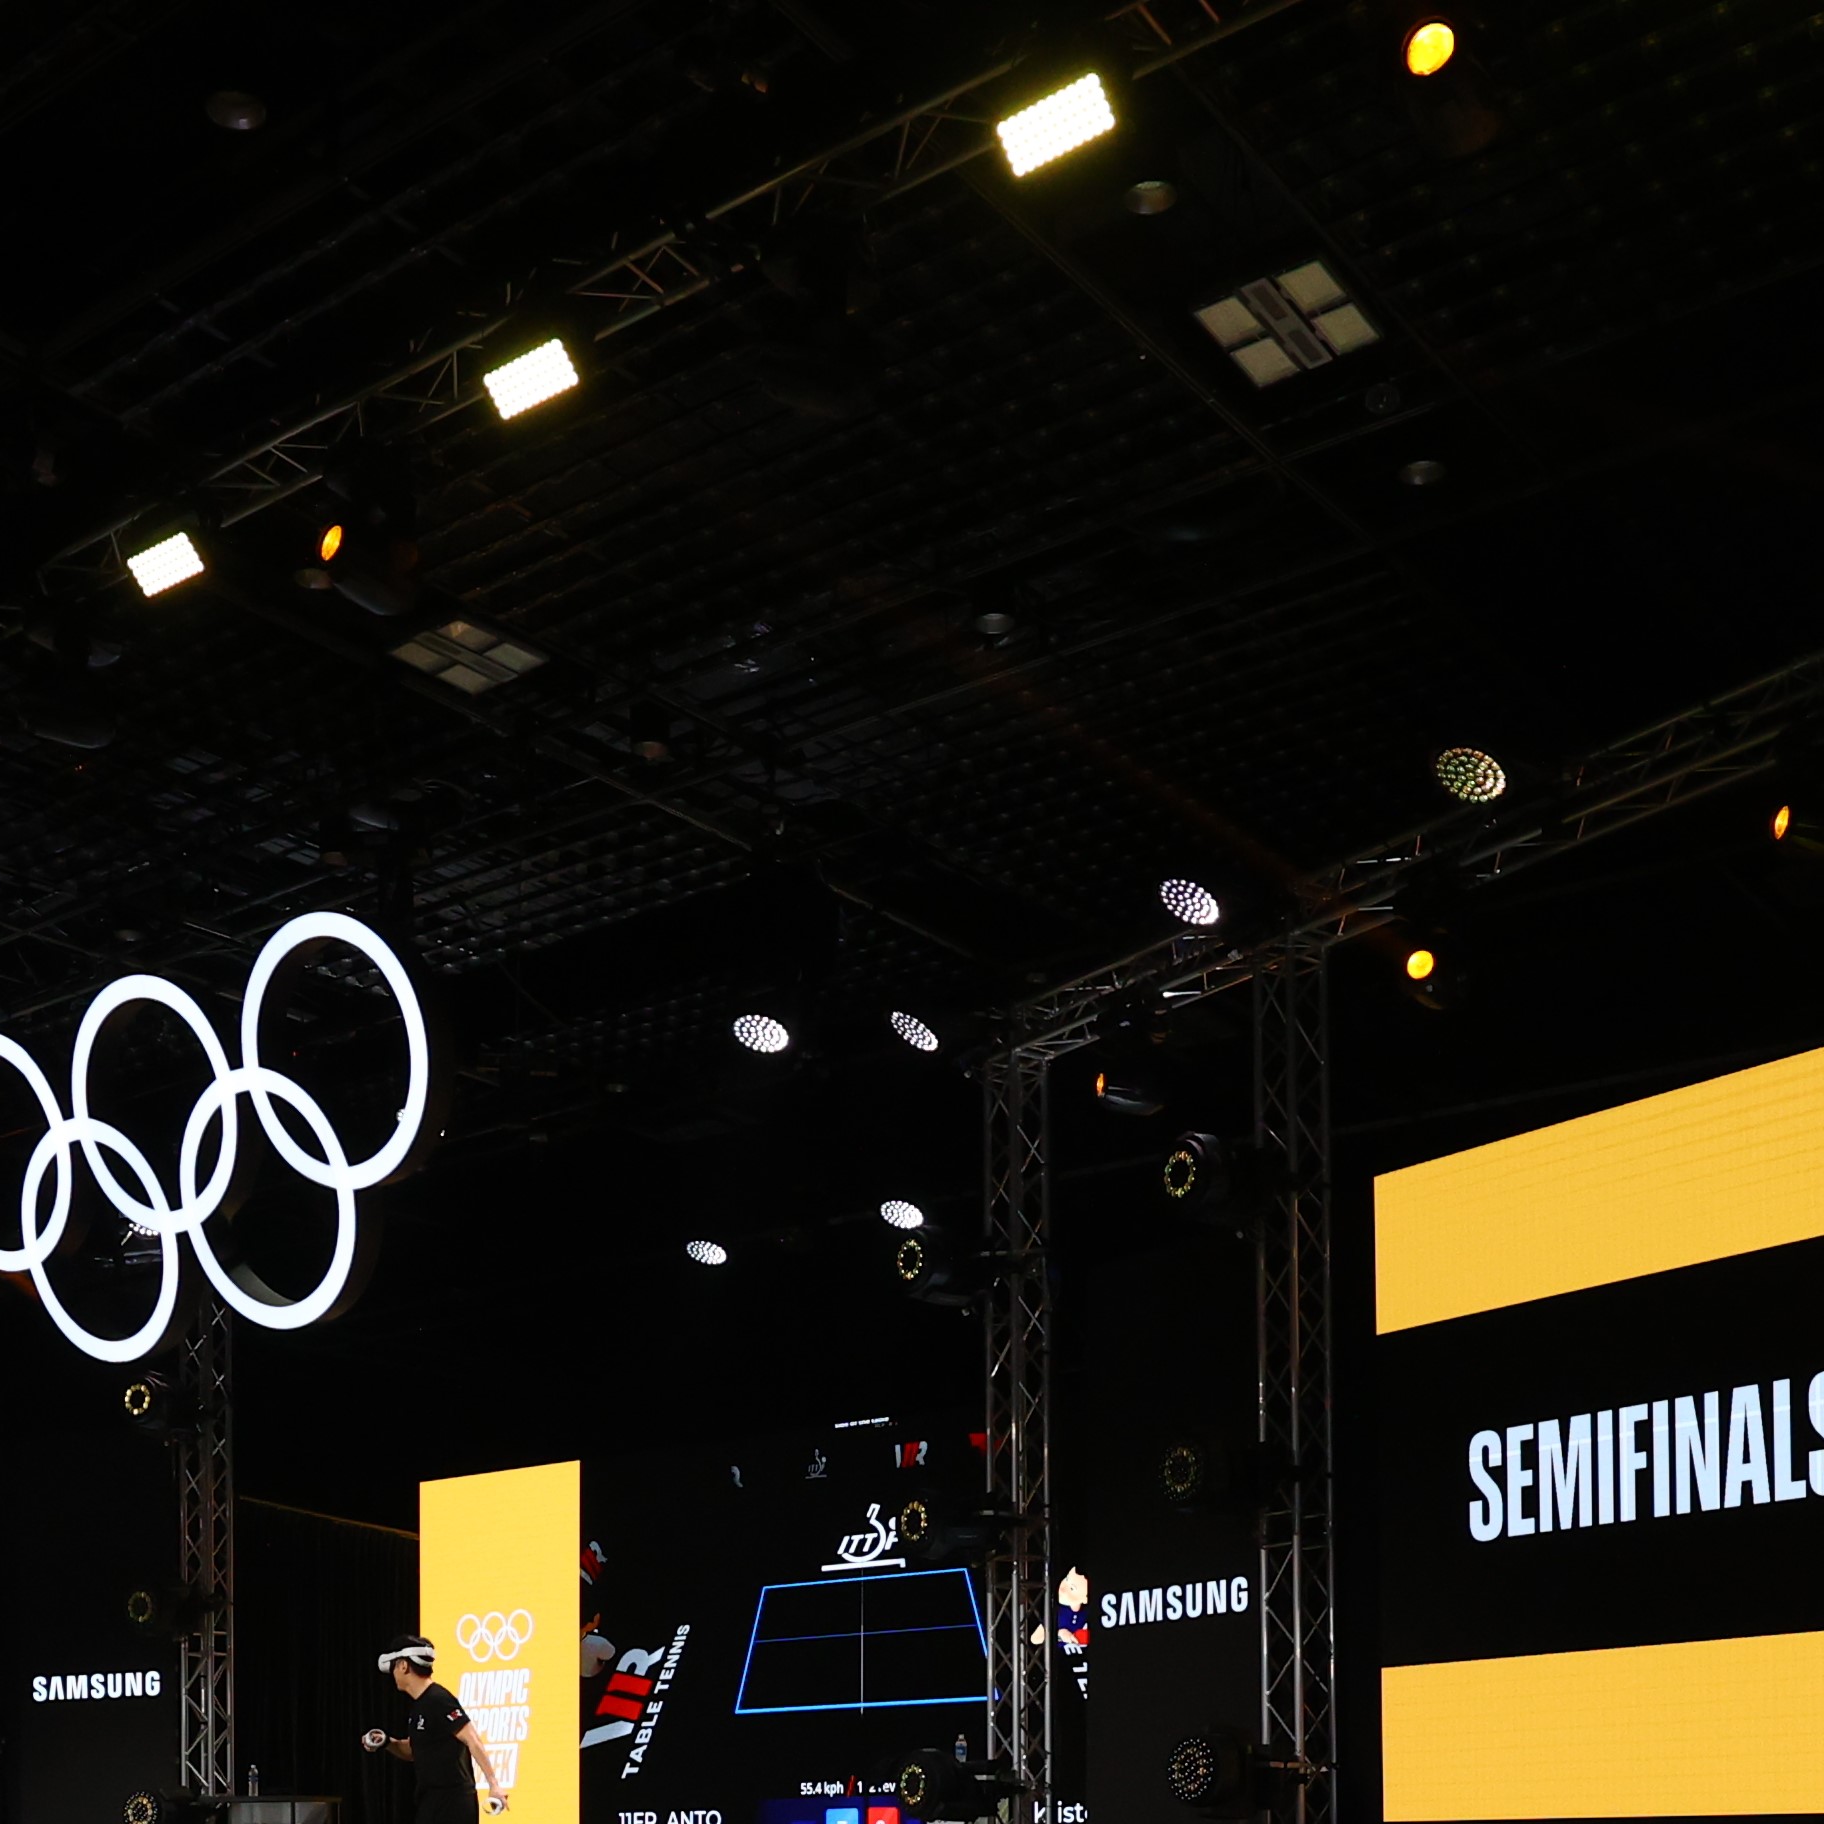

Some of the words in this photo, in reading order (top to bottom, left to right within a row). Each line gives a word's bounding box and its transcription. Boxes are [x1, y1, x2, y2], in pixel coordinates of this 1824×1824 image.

[1102, 1577, 1249, 1628] SAMSUNG
[33, 1671, 161, 1701] SAMSUNG
[459, 1667, 530, 1708] OLYMPIC
[621, 1701, 664, 1779] TABLE
[654, 1624, 690, 1694] TENNIS
[800, 1782, 822, 1795] 55.4
[823, 1780, 844, 1797] kph
